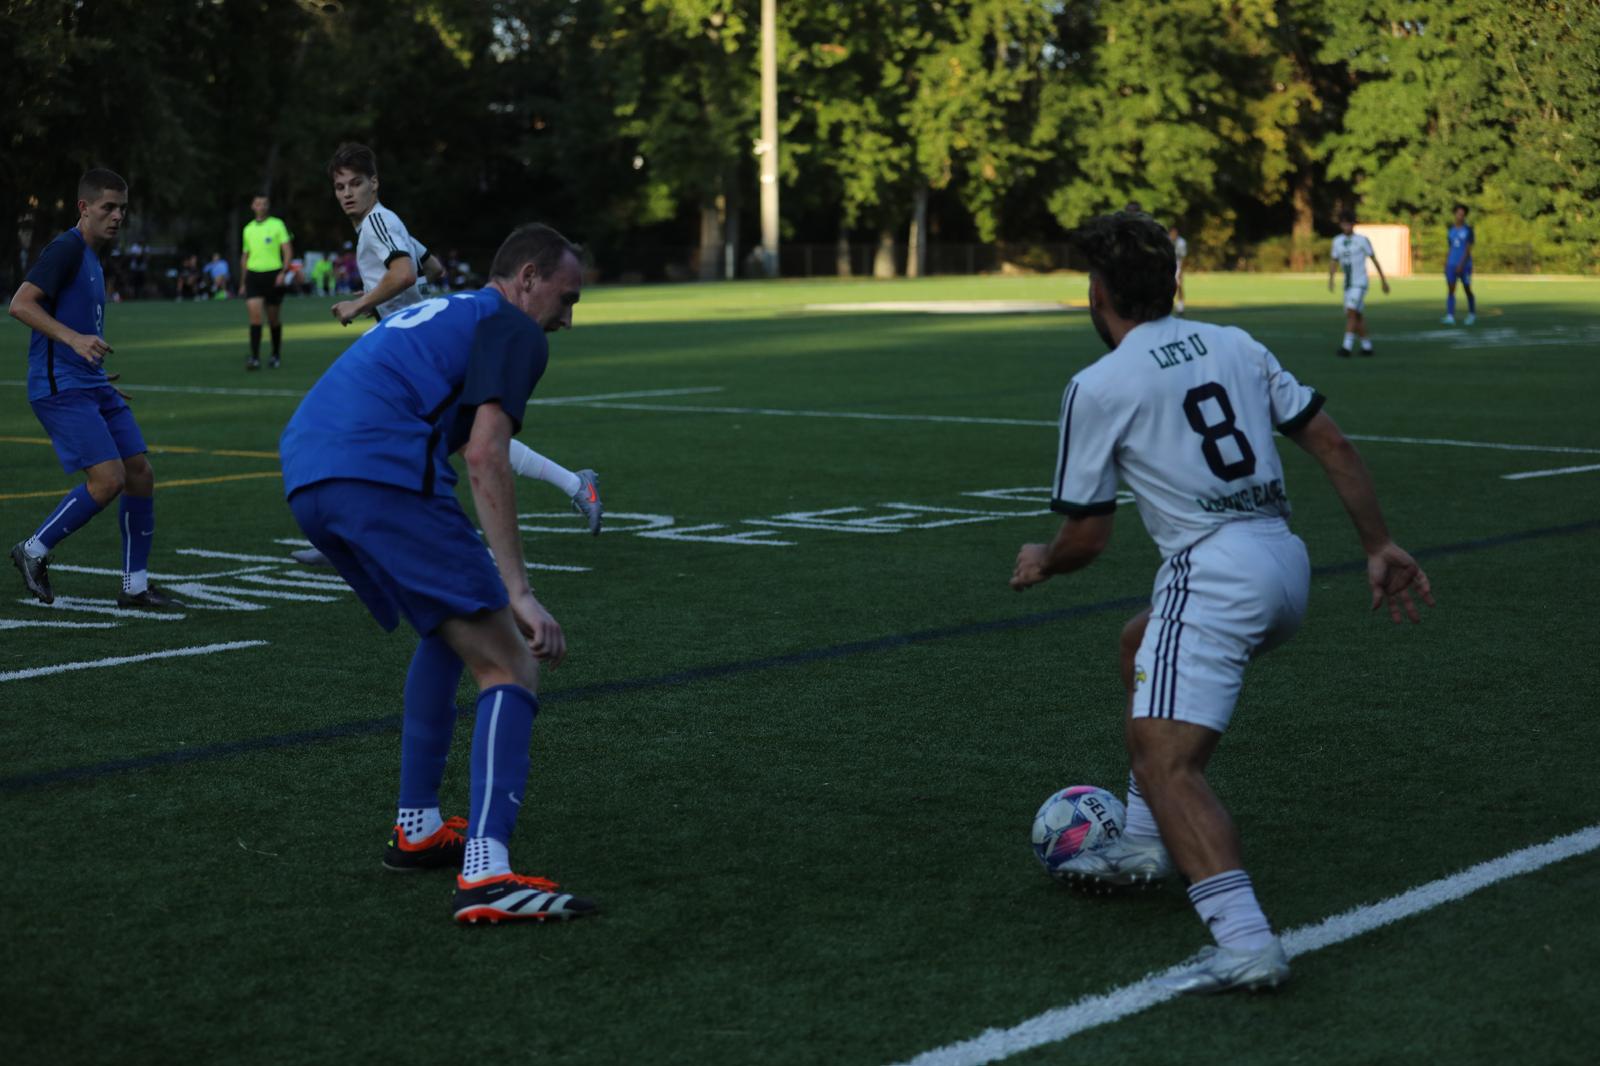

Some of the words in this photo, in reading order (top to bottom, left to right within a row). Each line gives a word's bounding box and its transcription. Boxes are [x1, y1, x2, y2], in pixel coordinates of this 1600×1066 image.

[1149, 340, 1192, 369] LIFE
[1188, 333, 1208, 357] U
[1183, 381, 1256, 483] 8
[636, 486, 1137, 546] FIELD
[1083, 796, 1121, 840] SELEC
